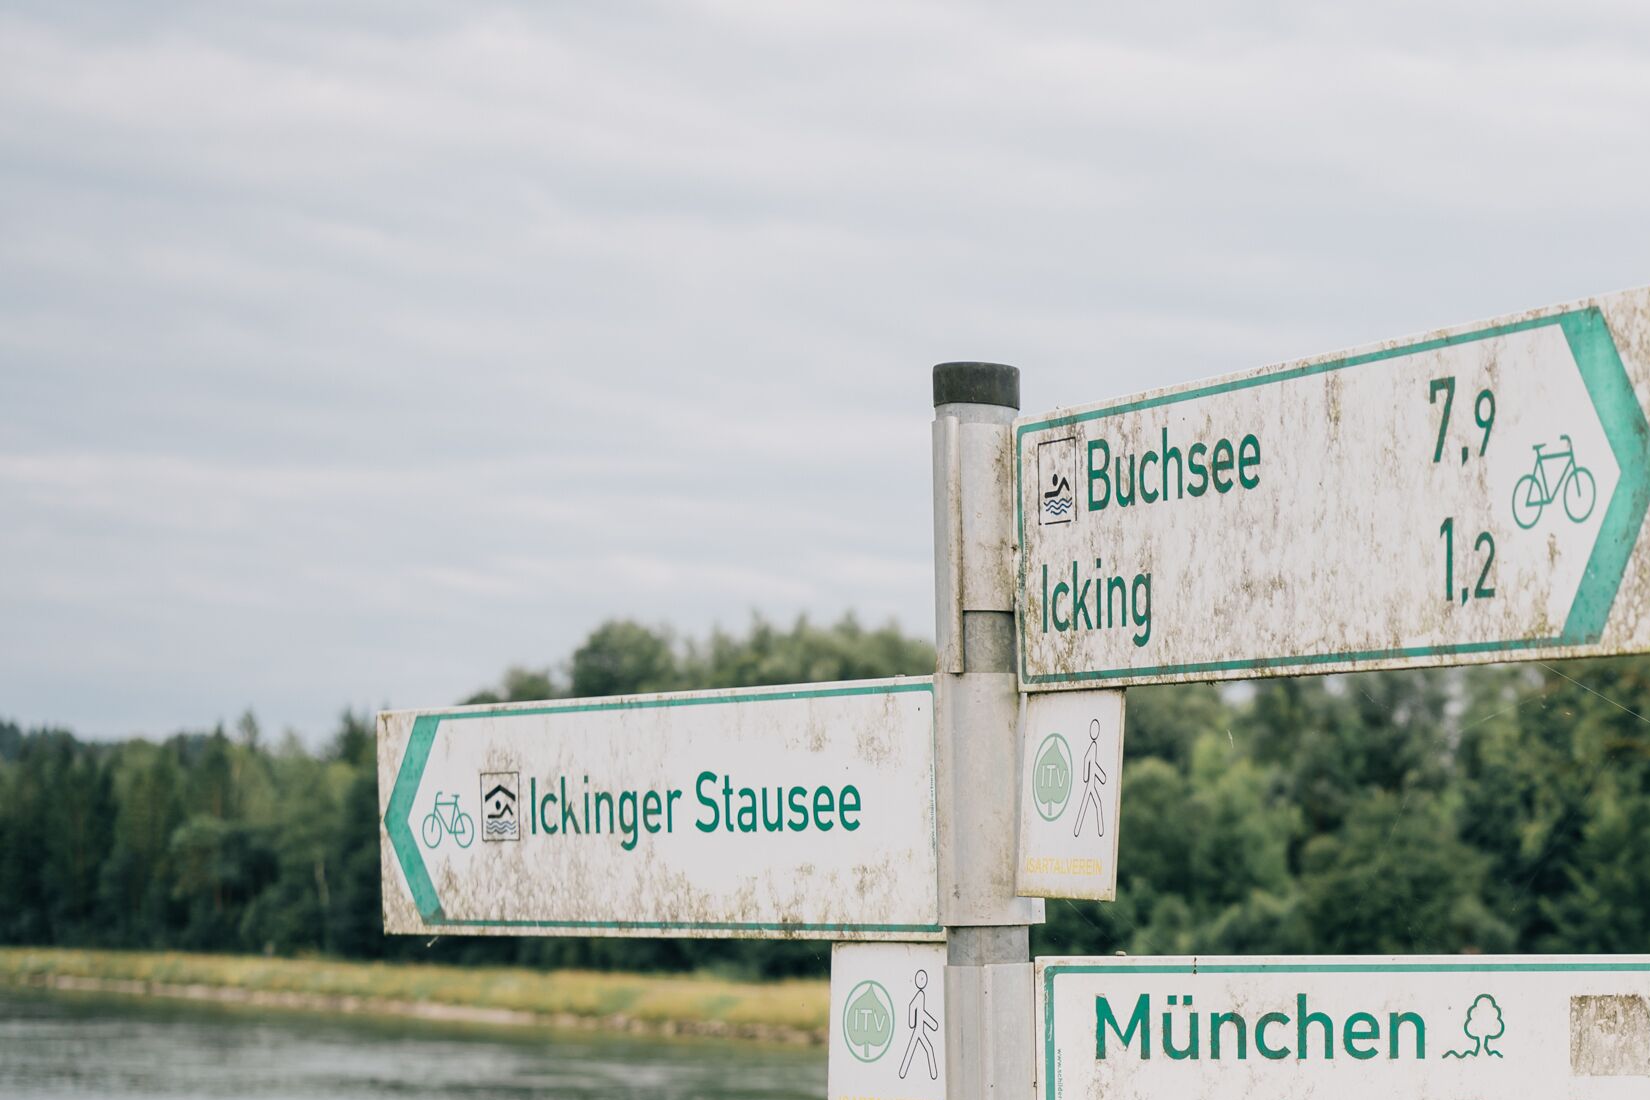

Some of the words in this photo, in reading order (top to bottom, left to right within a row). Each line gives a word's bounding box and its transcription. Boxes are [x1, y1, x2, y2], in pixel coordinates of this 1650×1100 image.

[1087, 428, 1261, 512] Buchsee
[1429, 376, 1496, 464] 7,9
[1042, 558, 1151, 647] Icking
[1439, 517, 1496, 605] 1,2
[1041, 764, 1066, 788] ITV
[530, 776, 682, 852] Ickinger
[694, 770, 862, 834] Stausee
[1026, 856, 1104, 876] ISARTALVEREIN
[854, 1008, 886, 1033] ITV
[1095, 993, 1426, 1060] München
